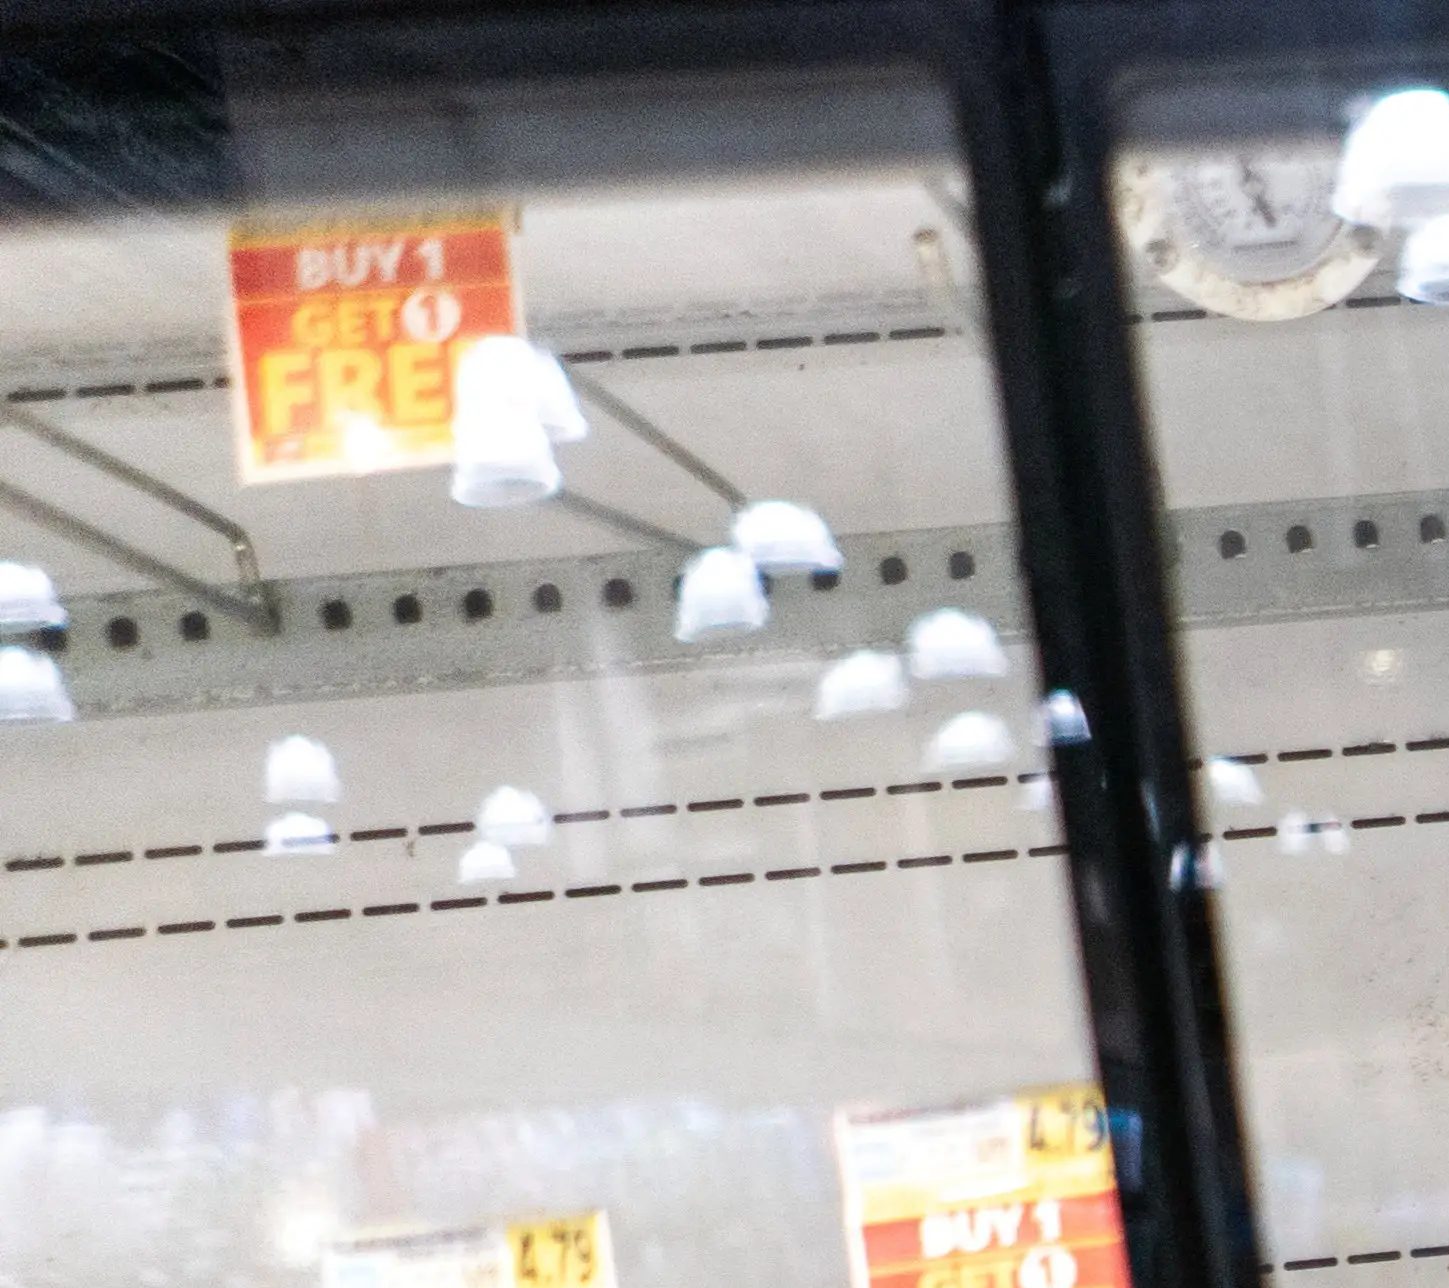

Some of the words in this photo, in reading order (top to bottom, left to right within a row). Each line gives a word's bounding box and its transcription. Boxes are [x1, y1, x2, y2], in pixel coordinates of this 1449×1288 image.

[297, 243, 398, 288] BUY
[418, 240, 444, 278] 1
[291, 298, 398, 346] GET
[260, 338, 470, 436] FRE
[920, 1204, 1023, 1259] BUY
[1032, 1200, 1060, 1241] 1
